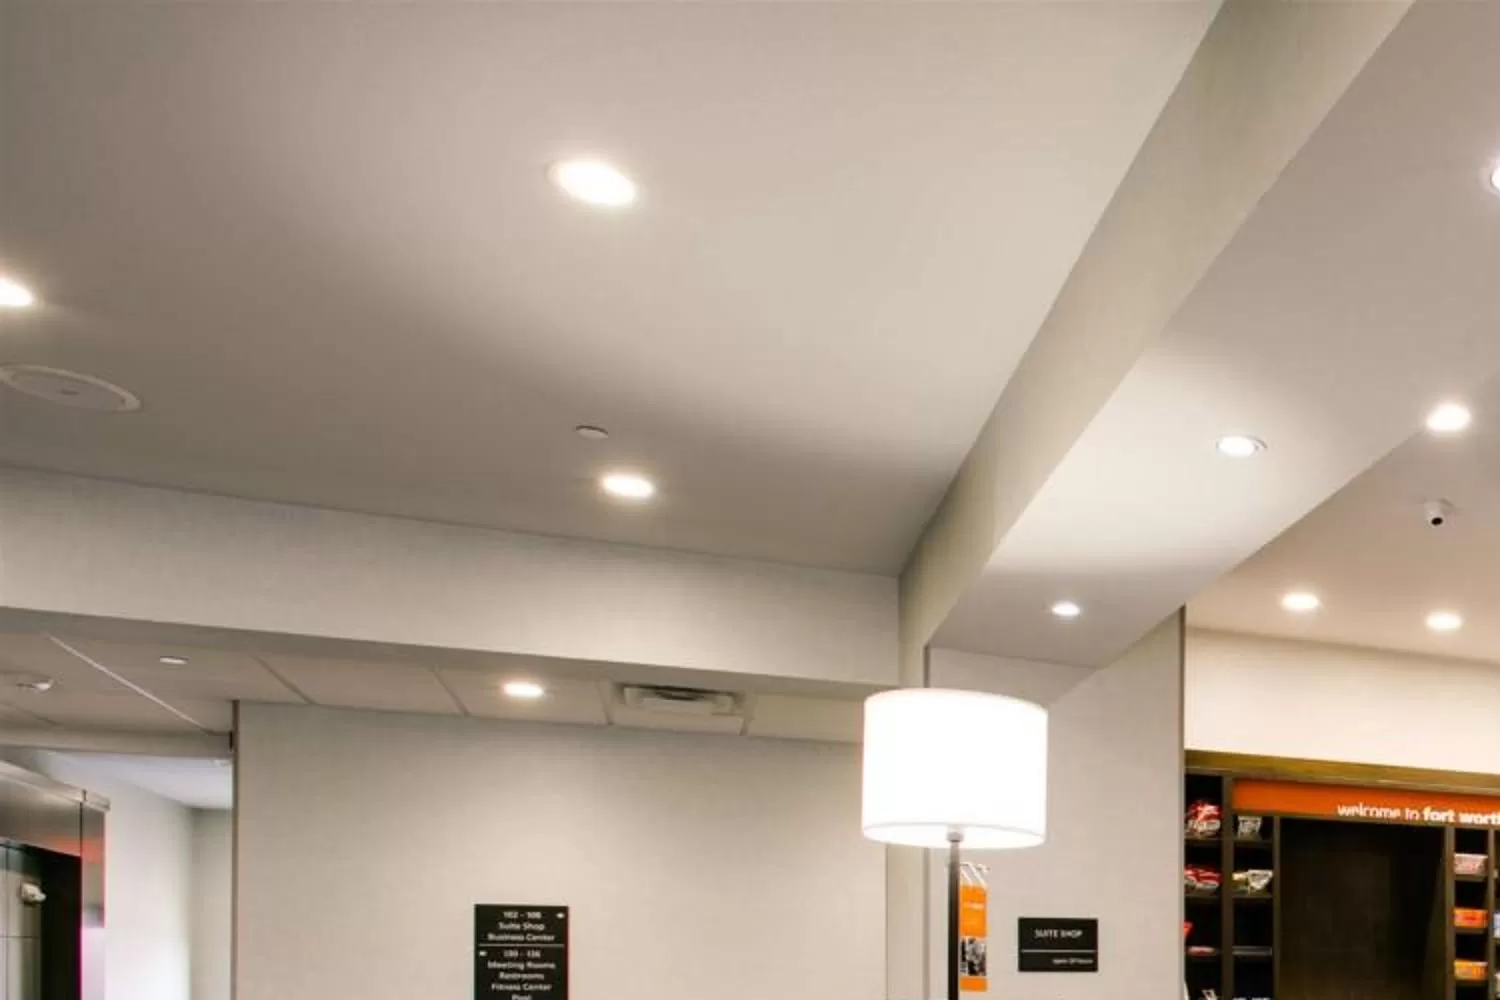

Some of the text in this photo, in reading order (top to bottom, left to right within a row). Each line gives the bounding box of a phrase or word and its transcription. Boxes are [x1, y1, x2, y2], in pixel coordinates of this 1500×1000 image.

[1337, 802, 1402, 820] welcome
[1405, 807, 1420, 821] to
[1423, 806, 1455, 823] fort
[522, 922, 545, 931] Shop
[526, 933, 556, 941] Center
[1034, 928, 1083, 939] SUITE SHOP
[522, 983, 552, 991] Center
